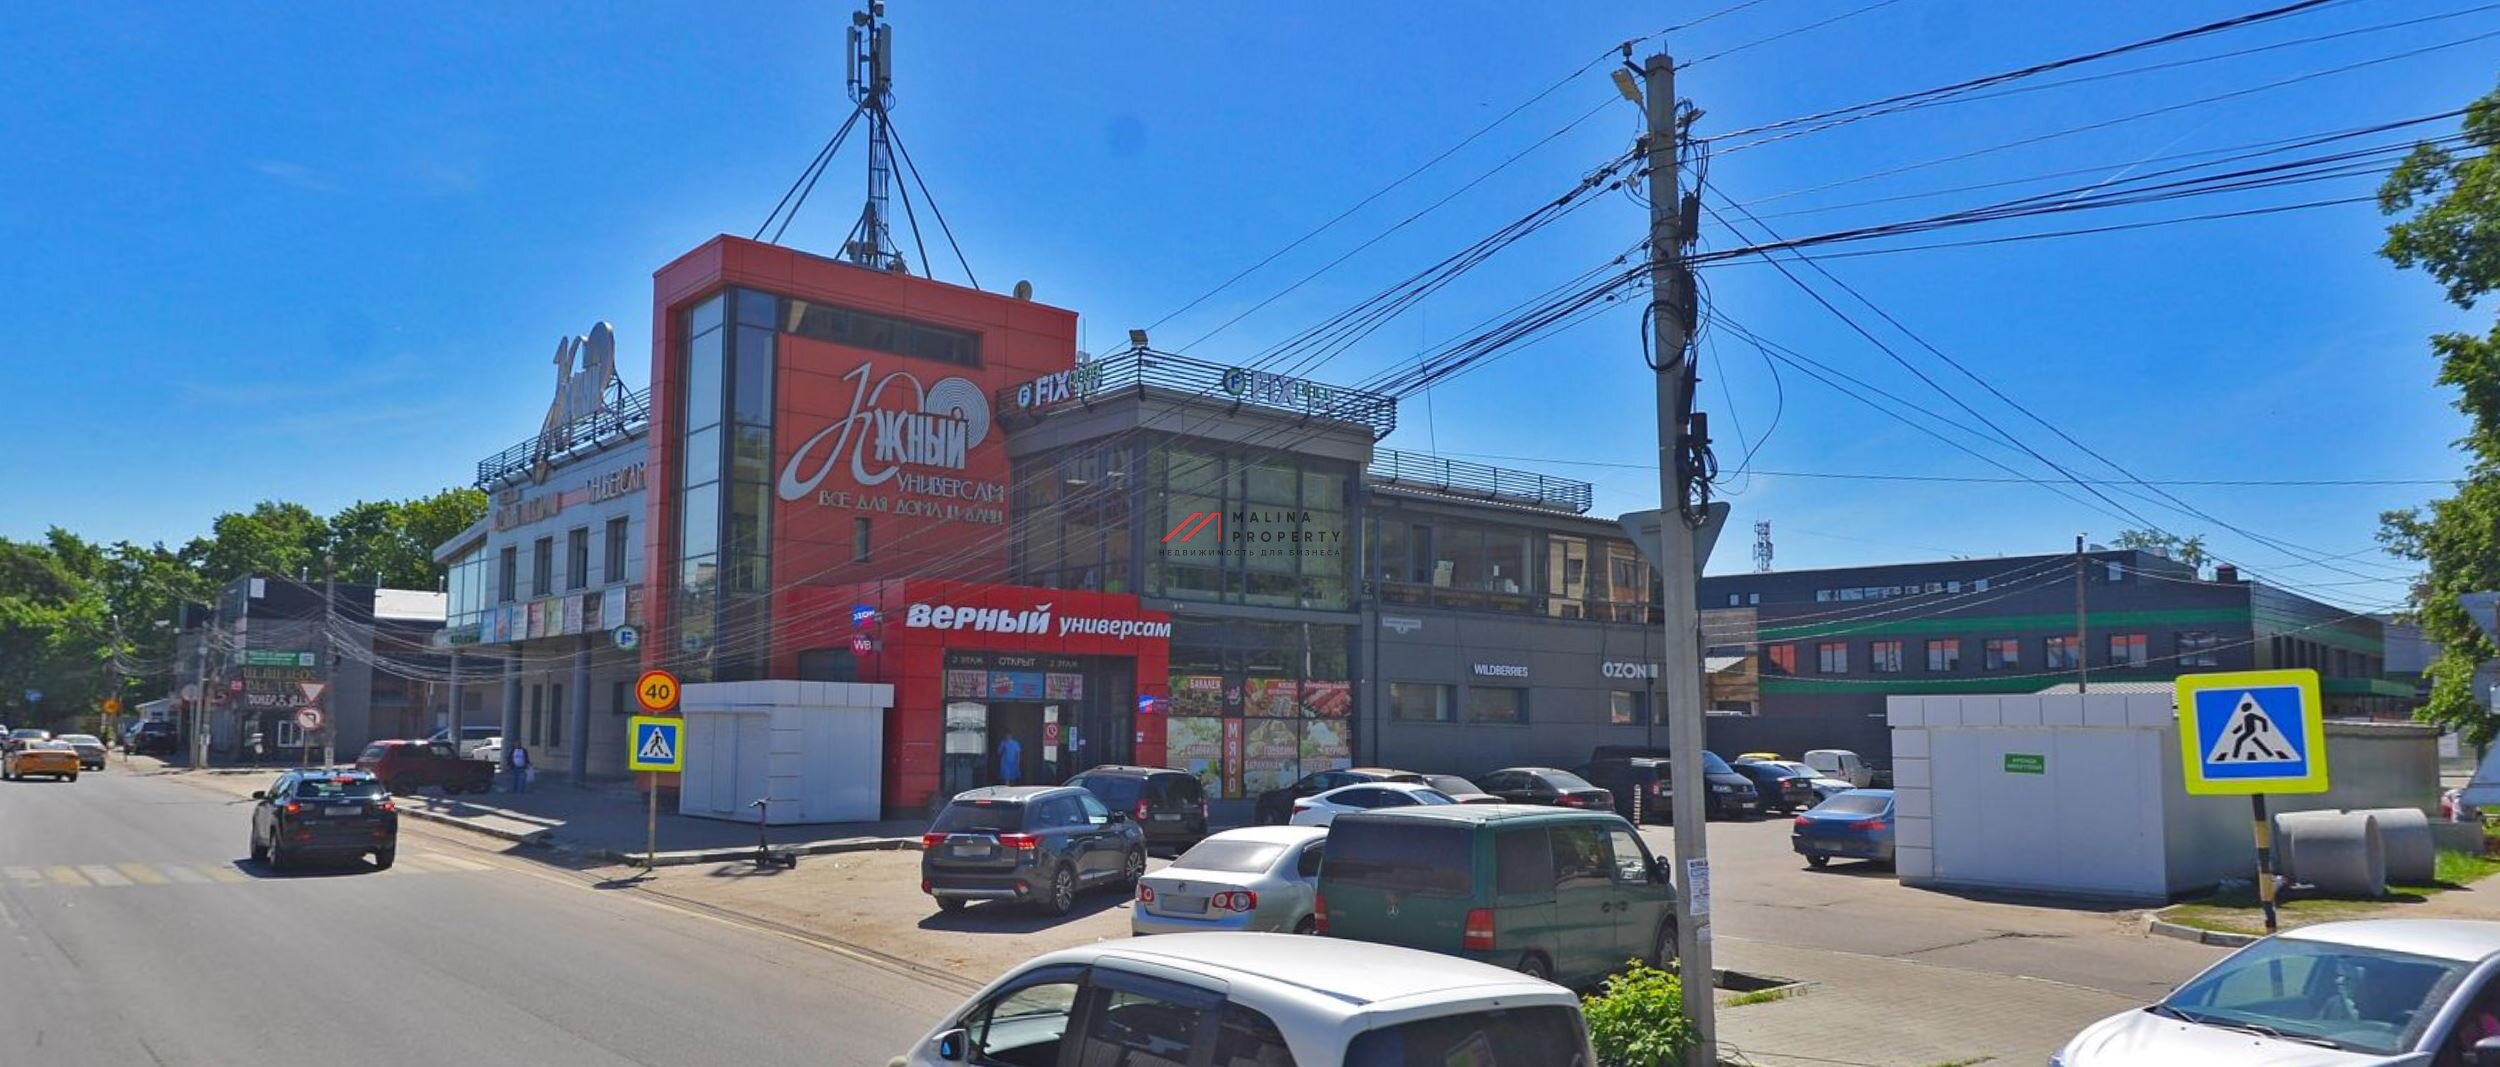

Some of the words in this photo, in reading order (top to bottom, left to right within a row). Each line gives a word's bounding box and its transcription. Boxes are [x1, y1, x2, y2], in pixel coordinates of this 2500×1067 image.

[896, 472, 1004, 504] УНИВЕРСАМ
[818, 490, 851, 508] ВСЕ
[1059, 615, 1172, 640] универсам
[853, 639, 872, 650] WB
[998, 656, 1036, 668] ОТКРЫТ
[1474, 663, 1528, 678] WILDBERRIES
[1602, 661, 1647, 679] OZON
[645, 684, 670, 700] 40
[1227, 723, 1239, 793] МЯСО
